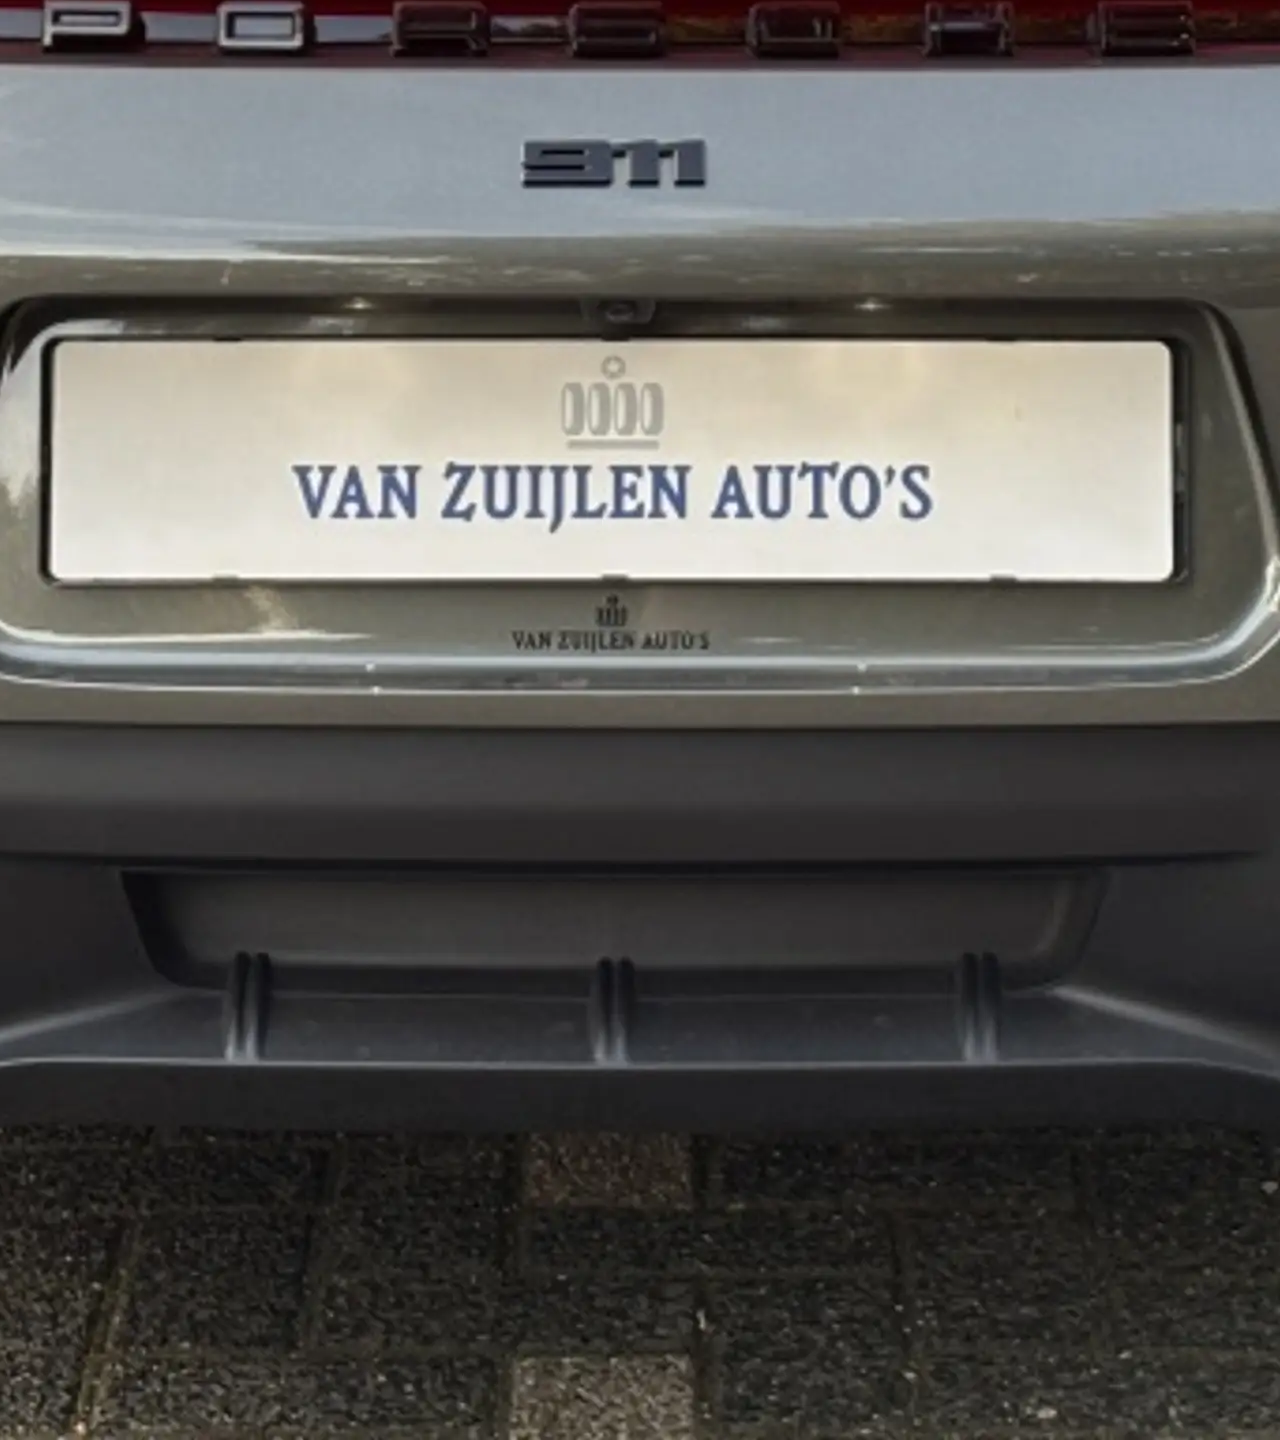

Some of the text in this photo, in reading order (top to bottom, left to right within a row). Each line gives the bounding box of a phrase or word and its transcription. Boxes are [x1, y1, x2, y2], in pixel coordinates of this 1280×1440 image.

[521, 139, 707, 189] 911
[293, 460, 935, 534] VAN ZUIJLEN AUTO'S
[511, 629, 712, 653] VAN ZUIJLEN AUTO'S
